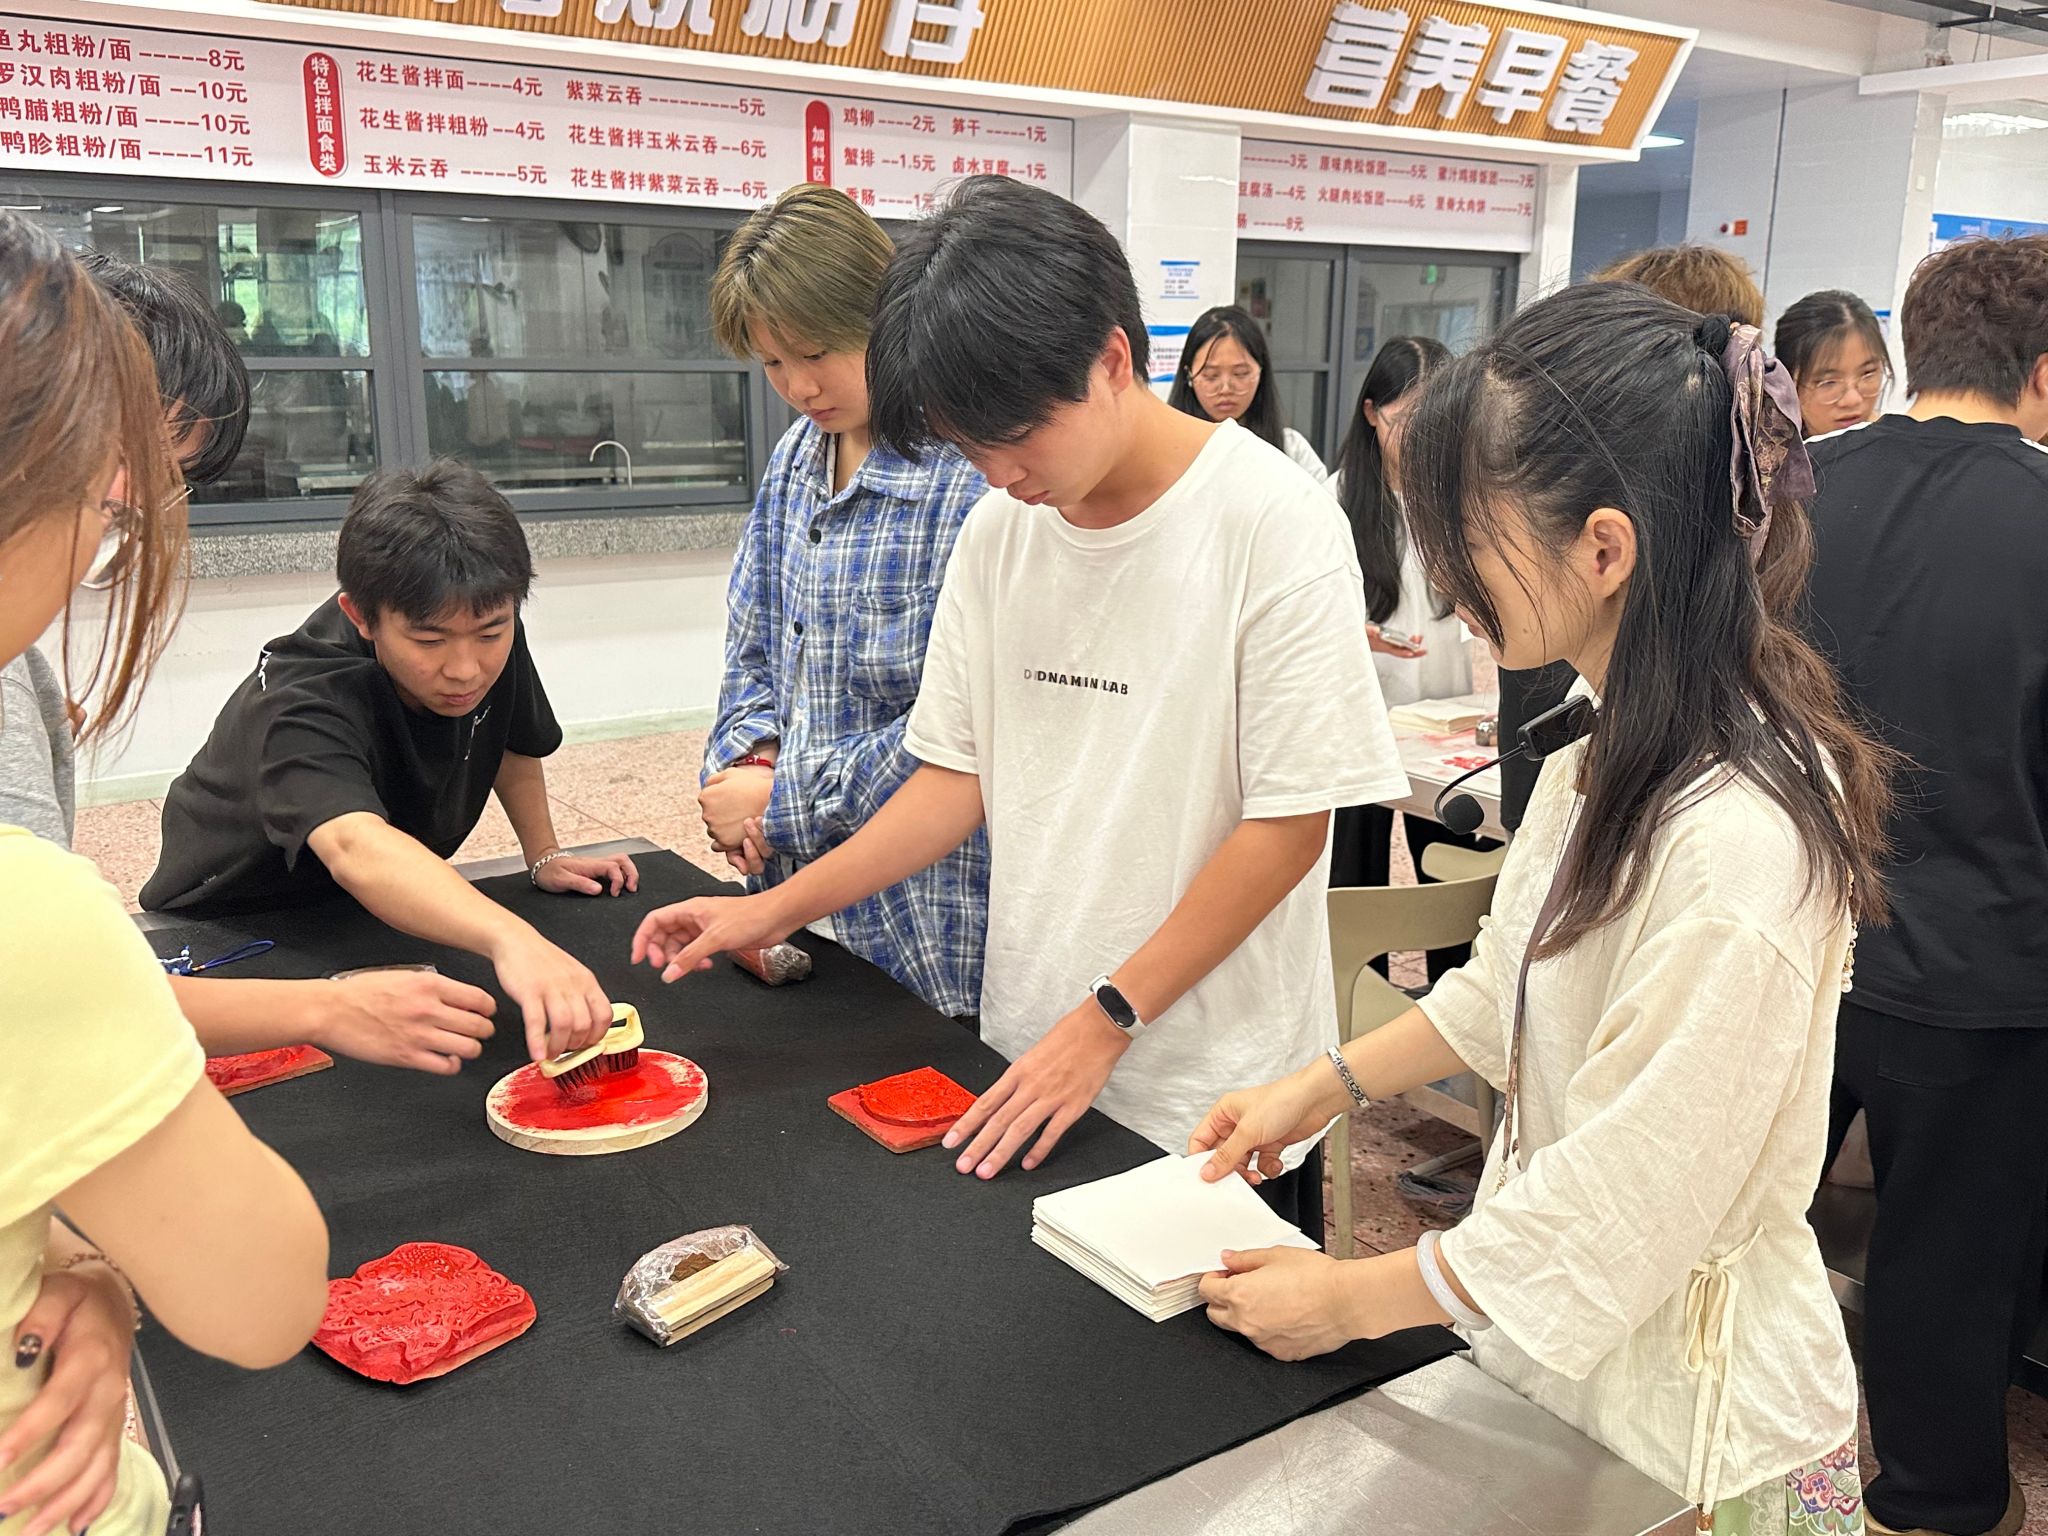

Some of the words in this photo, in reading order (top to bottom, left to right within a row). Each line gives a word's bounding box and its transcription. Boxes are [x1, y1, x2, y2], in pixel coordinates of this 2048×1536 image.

[356, 60, 464, 90] 花生酱拌面
[1304, 1, 1640, 134] 营养早餐
[566, 80, 642, 106] 紫菜云吞
[311, 56, 337, 172] 特色拌面食类
[359, 107, 489, 137] 花生酱拌粗粉
[843, 107, 875, 127] 鸡柳
[952, 117, 981, 137] 笋干
[568, 123, 719, 154] 花生酱拌玉米云吞
[363, 154, 449, 179] 玉米云吞
[811, 125, 827, 183] 加料区
[570, 167, 719, 196] 花生酱拌紫菜云吞
